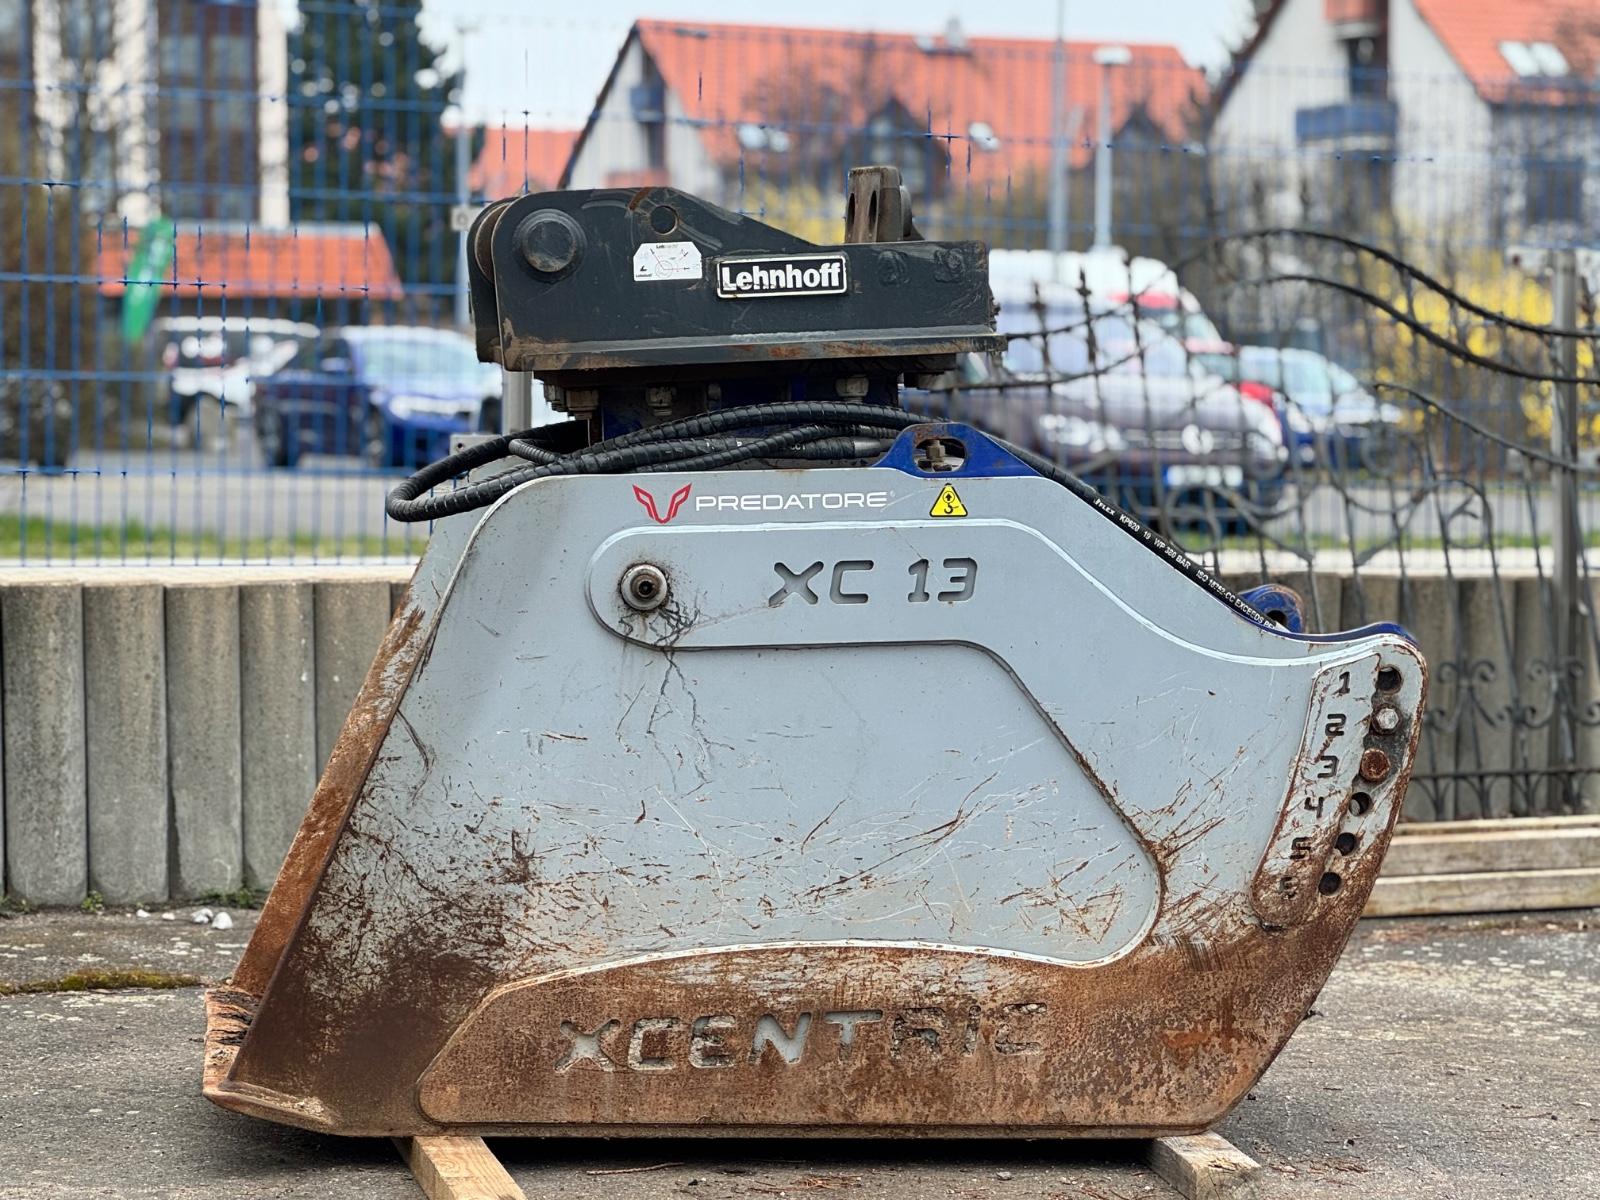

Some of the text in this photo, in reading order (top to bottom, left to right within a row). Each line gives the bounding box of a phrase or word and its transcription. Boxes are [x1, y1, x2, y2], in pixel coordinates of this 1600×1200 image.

[722, 262, 842, 291] Lehnhoff
[695, 490, 888, 512] PREDATORE
[1119, 513, 1141, 533] KP620
[1143, 530, 1153, 540] 19
[1153, 537, 1166, 549] WP
[1175, 554, 1192, 570] BAR
[1196, 569, 1209, 582] ISO
[1234, 598, 1265, 624] EXCEEDS
[768, 557, 979, 607] XC 13
[1337, 671, 1351, 695] 1
[1324, 713, 1347, 737] 2
[1316, 754, 1340, 779] 3
[1303, 795, 1325, 819] 4
[1289, 836, 1312, 860] 5
[553, 1001, 1048, 1074] XCENTRIC
